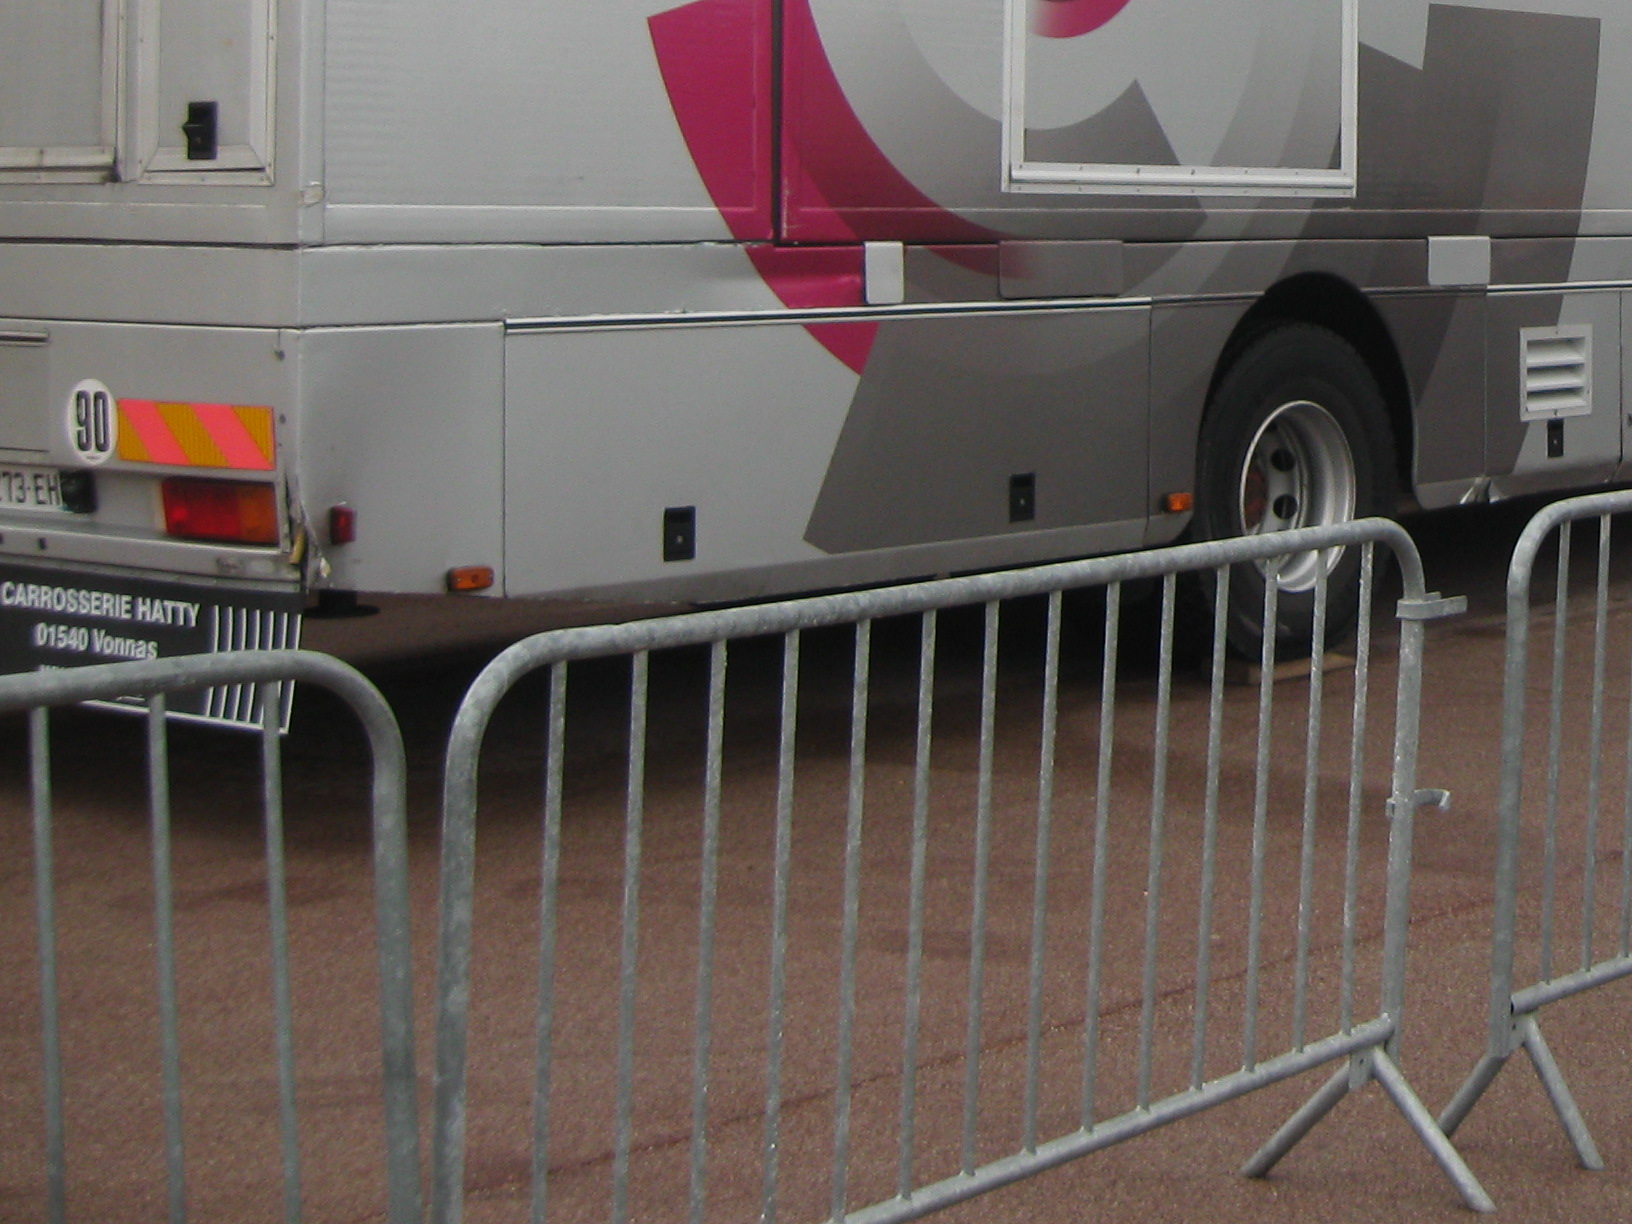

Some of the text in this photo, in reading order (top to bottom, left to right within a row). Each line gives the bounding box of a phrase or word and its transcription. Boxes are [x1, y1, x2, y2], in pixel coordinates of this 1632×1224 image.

[76, 389, 111, 453] 90
[0, 470, 60, 506] 73-EH
[1, 580, 200, 628] CARROSSERIE HATTY
[35, 621, 160, 660] 01540 Vonnas
